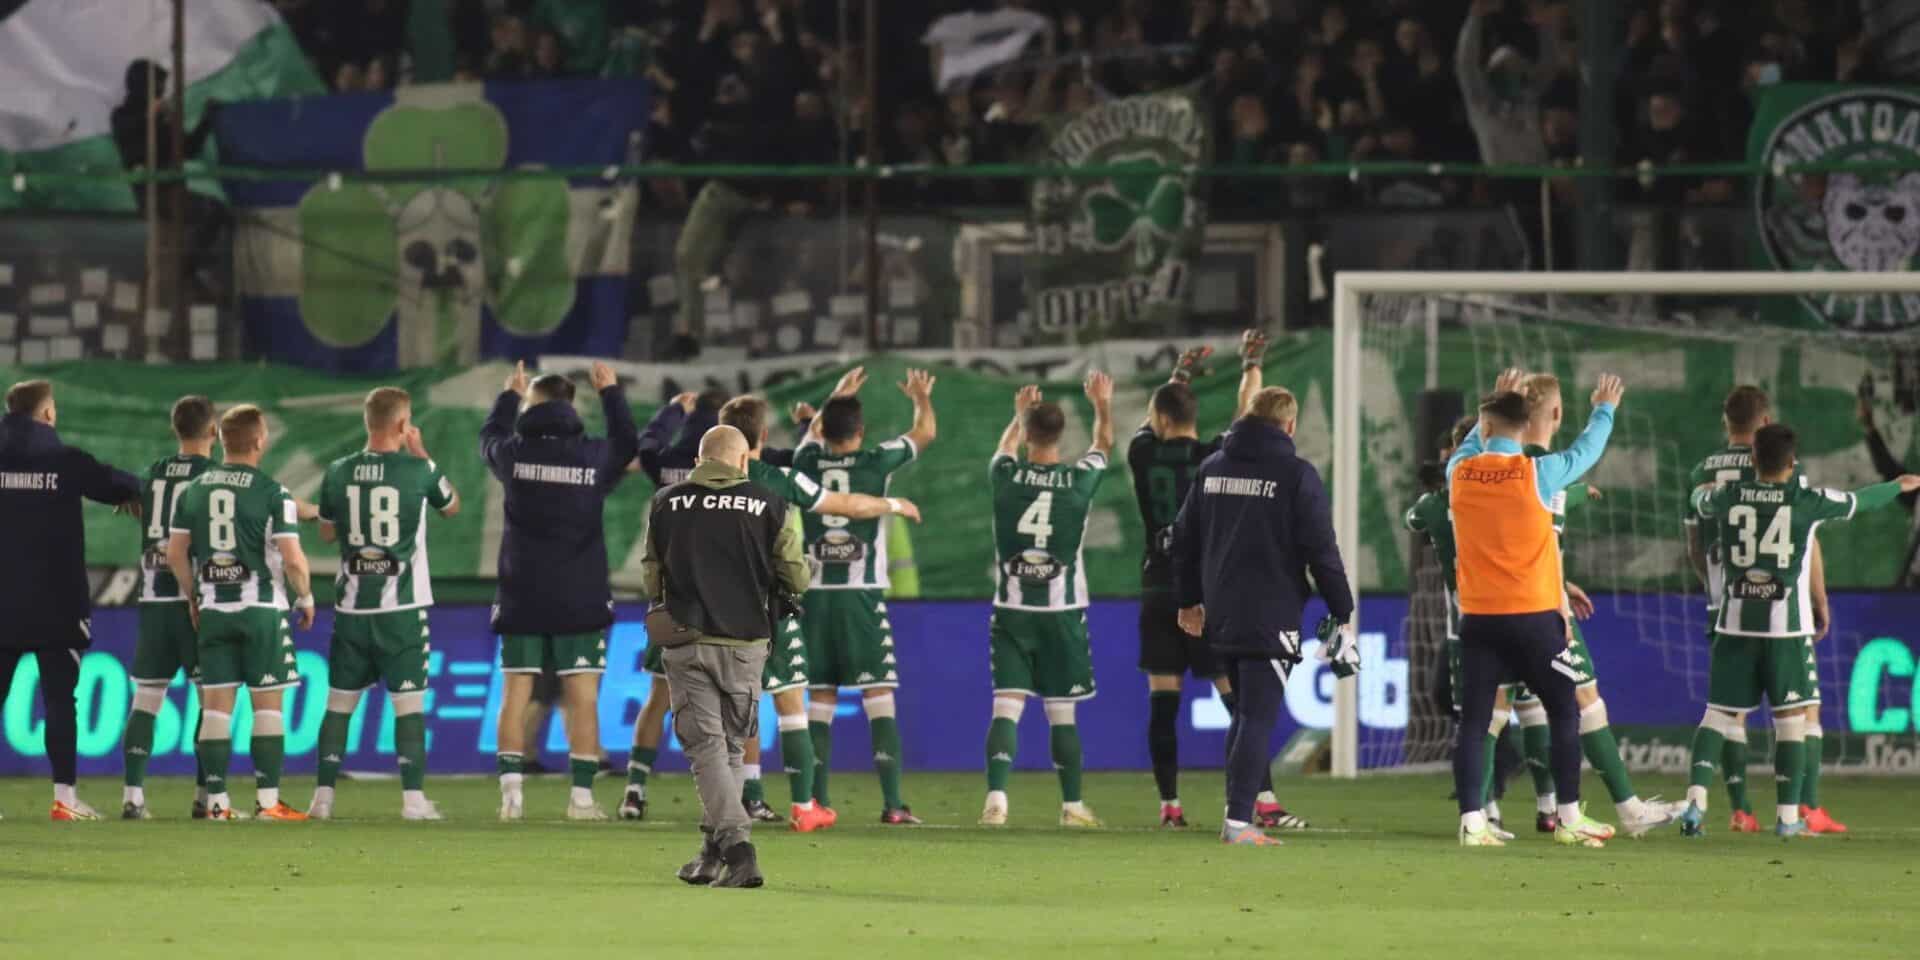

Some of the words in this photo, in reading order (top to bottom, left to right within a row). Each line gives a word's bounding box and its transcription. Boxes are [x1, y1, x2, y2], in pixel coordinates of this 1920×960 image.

[46, 472, 58, 489] FC
[584, 468, 595, 486] FC
[1263, 481, 1277, 499] FC
[669, 495, 697, 512] TV
[702, 494, 767, 516] CREW
[209, 488, 237, 551] 8
[345, 485, 400, 547] 18
[1017, 490, 1053, 549] 4
[1728, 505, 1795, 569] 34
[821, 543, 855, 558] Fuego
[208, 565, 243, 580] Fuego
[356, 559, 391, 574] Fuego
[1017, 561, 1054, 578] Fuego
[1740, 582, 1777, 598] Fuego
